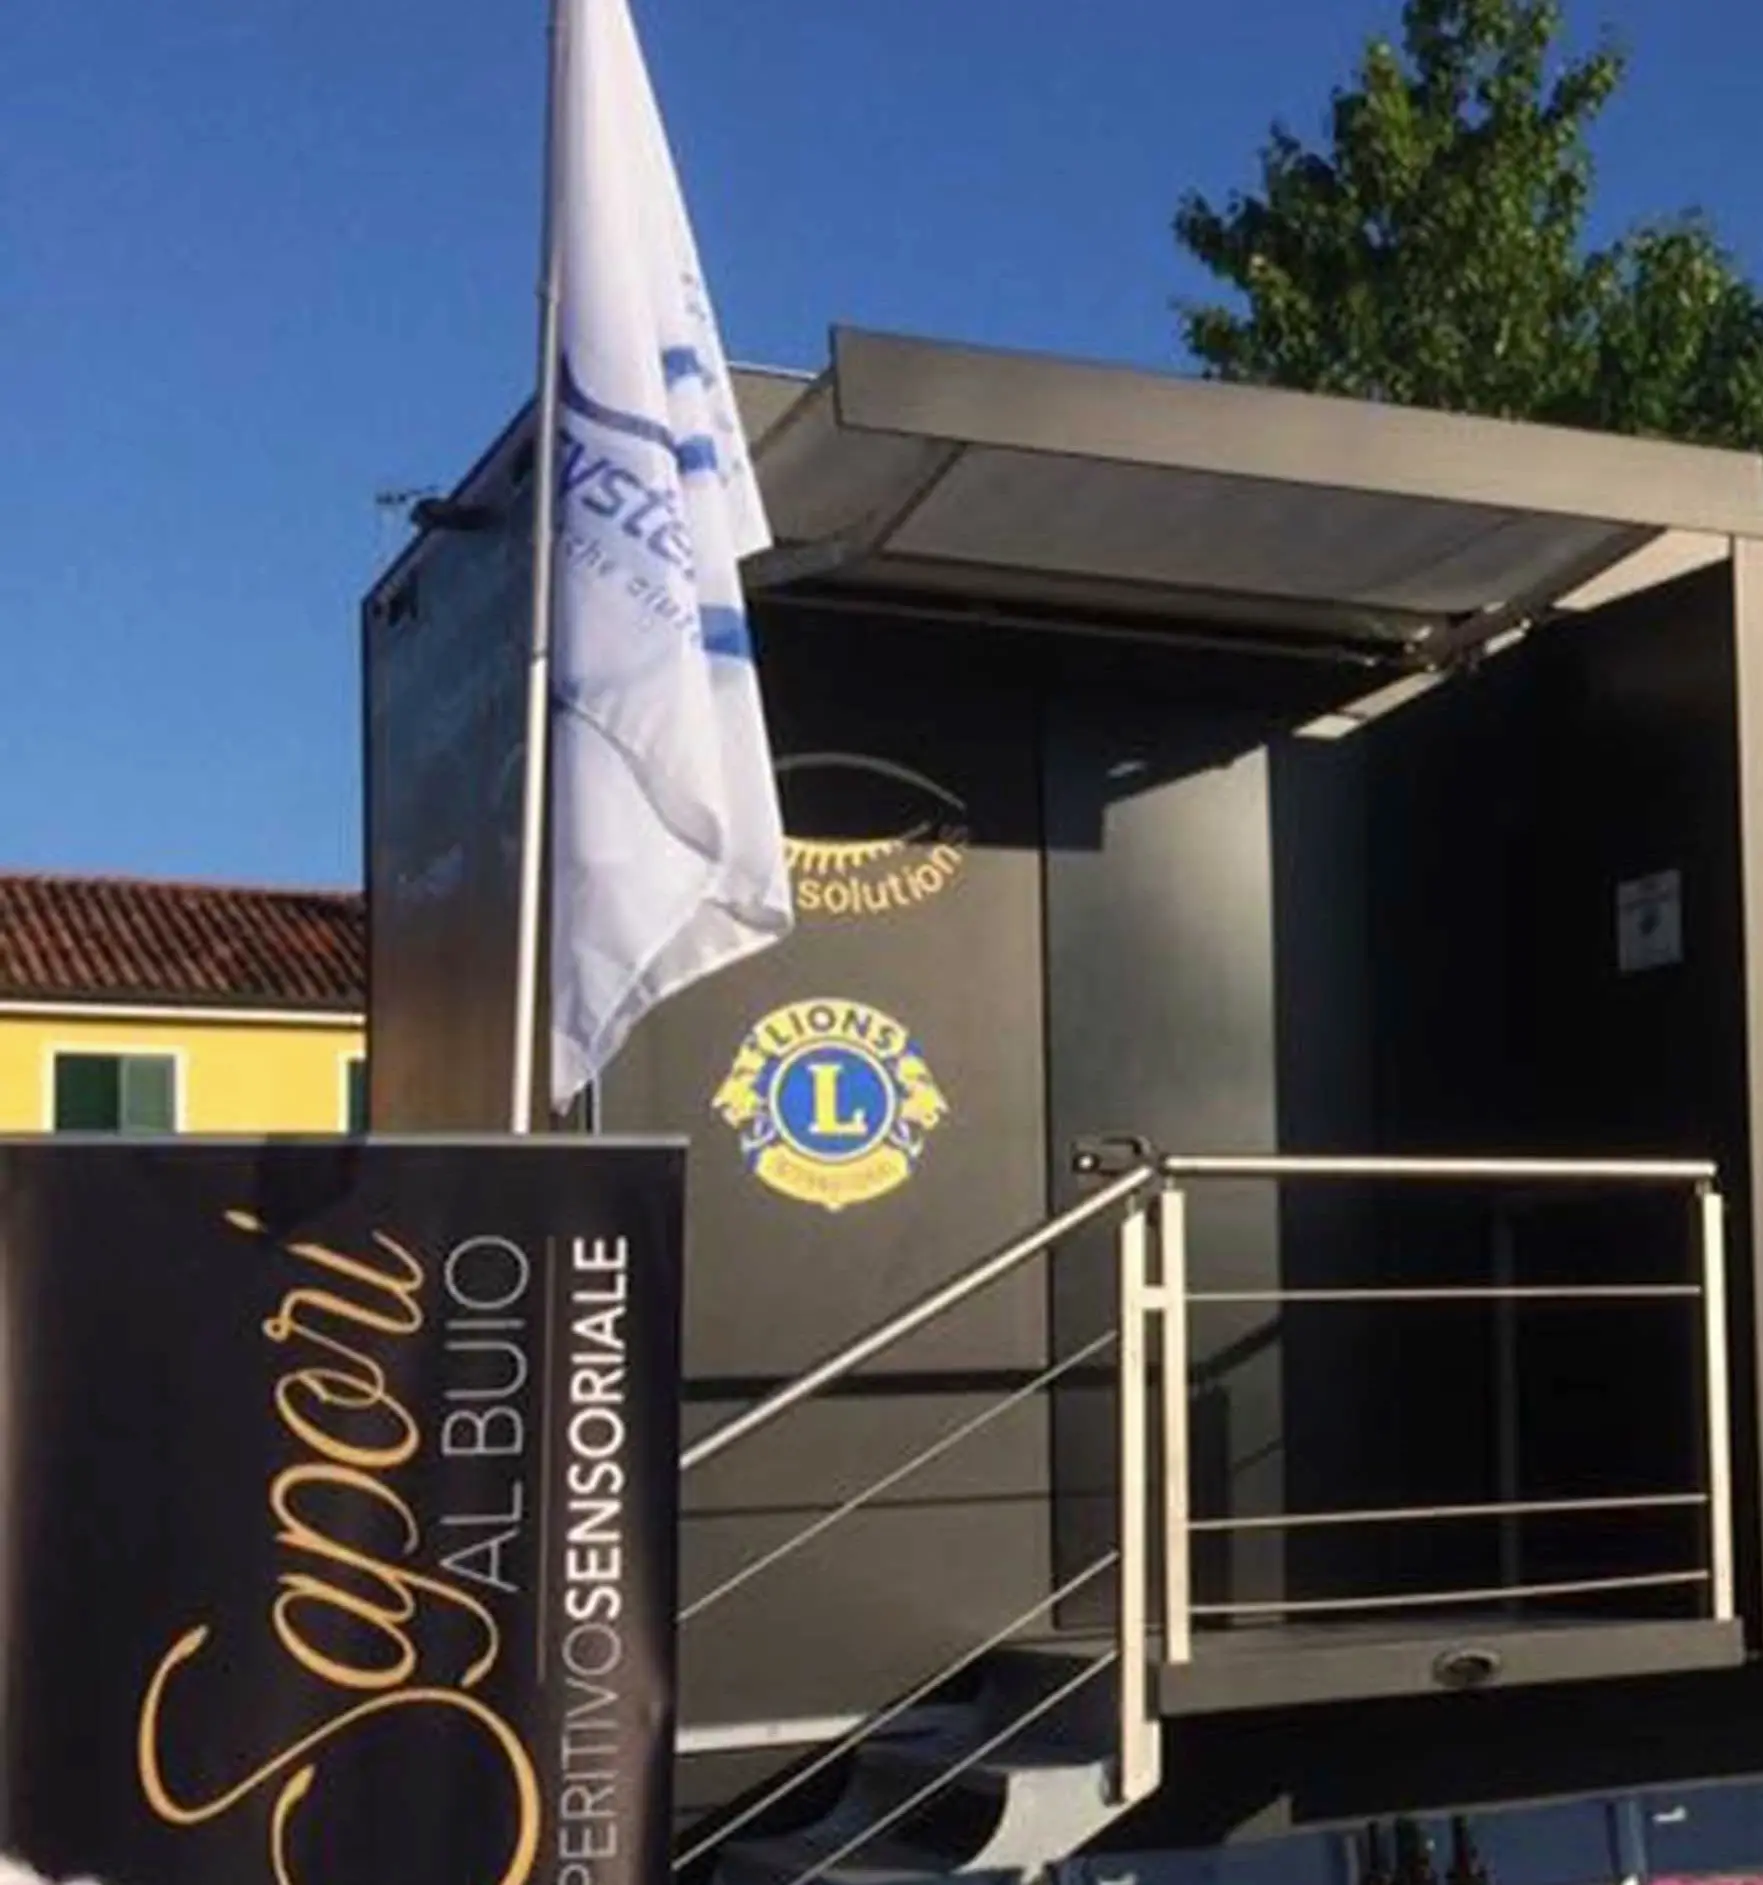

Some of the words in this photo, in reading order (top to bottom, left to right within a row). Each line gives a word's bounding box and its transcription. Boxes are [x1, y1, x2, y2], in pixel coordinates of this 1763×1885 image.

[763, 1003, 899, 1052] LIONS
[806, 1062, 869, 1137] L
[441, 1234, 530, 1457] BUIO
[138, 1208, 541, 1885] Sapori
[440, 1481, 524, 1593] AL
